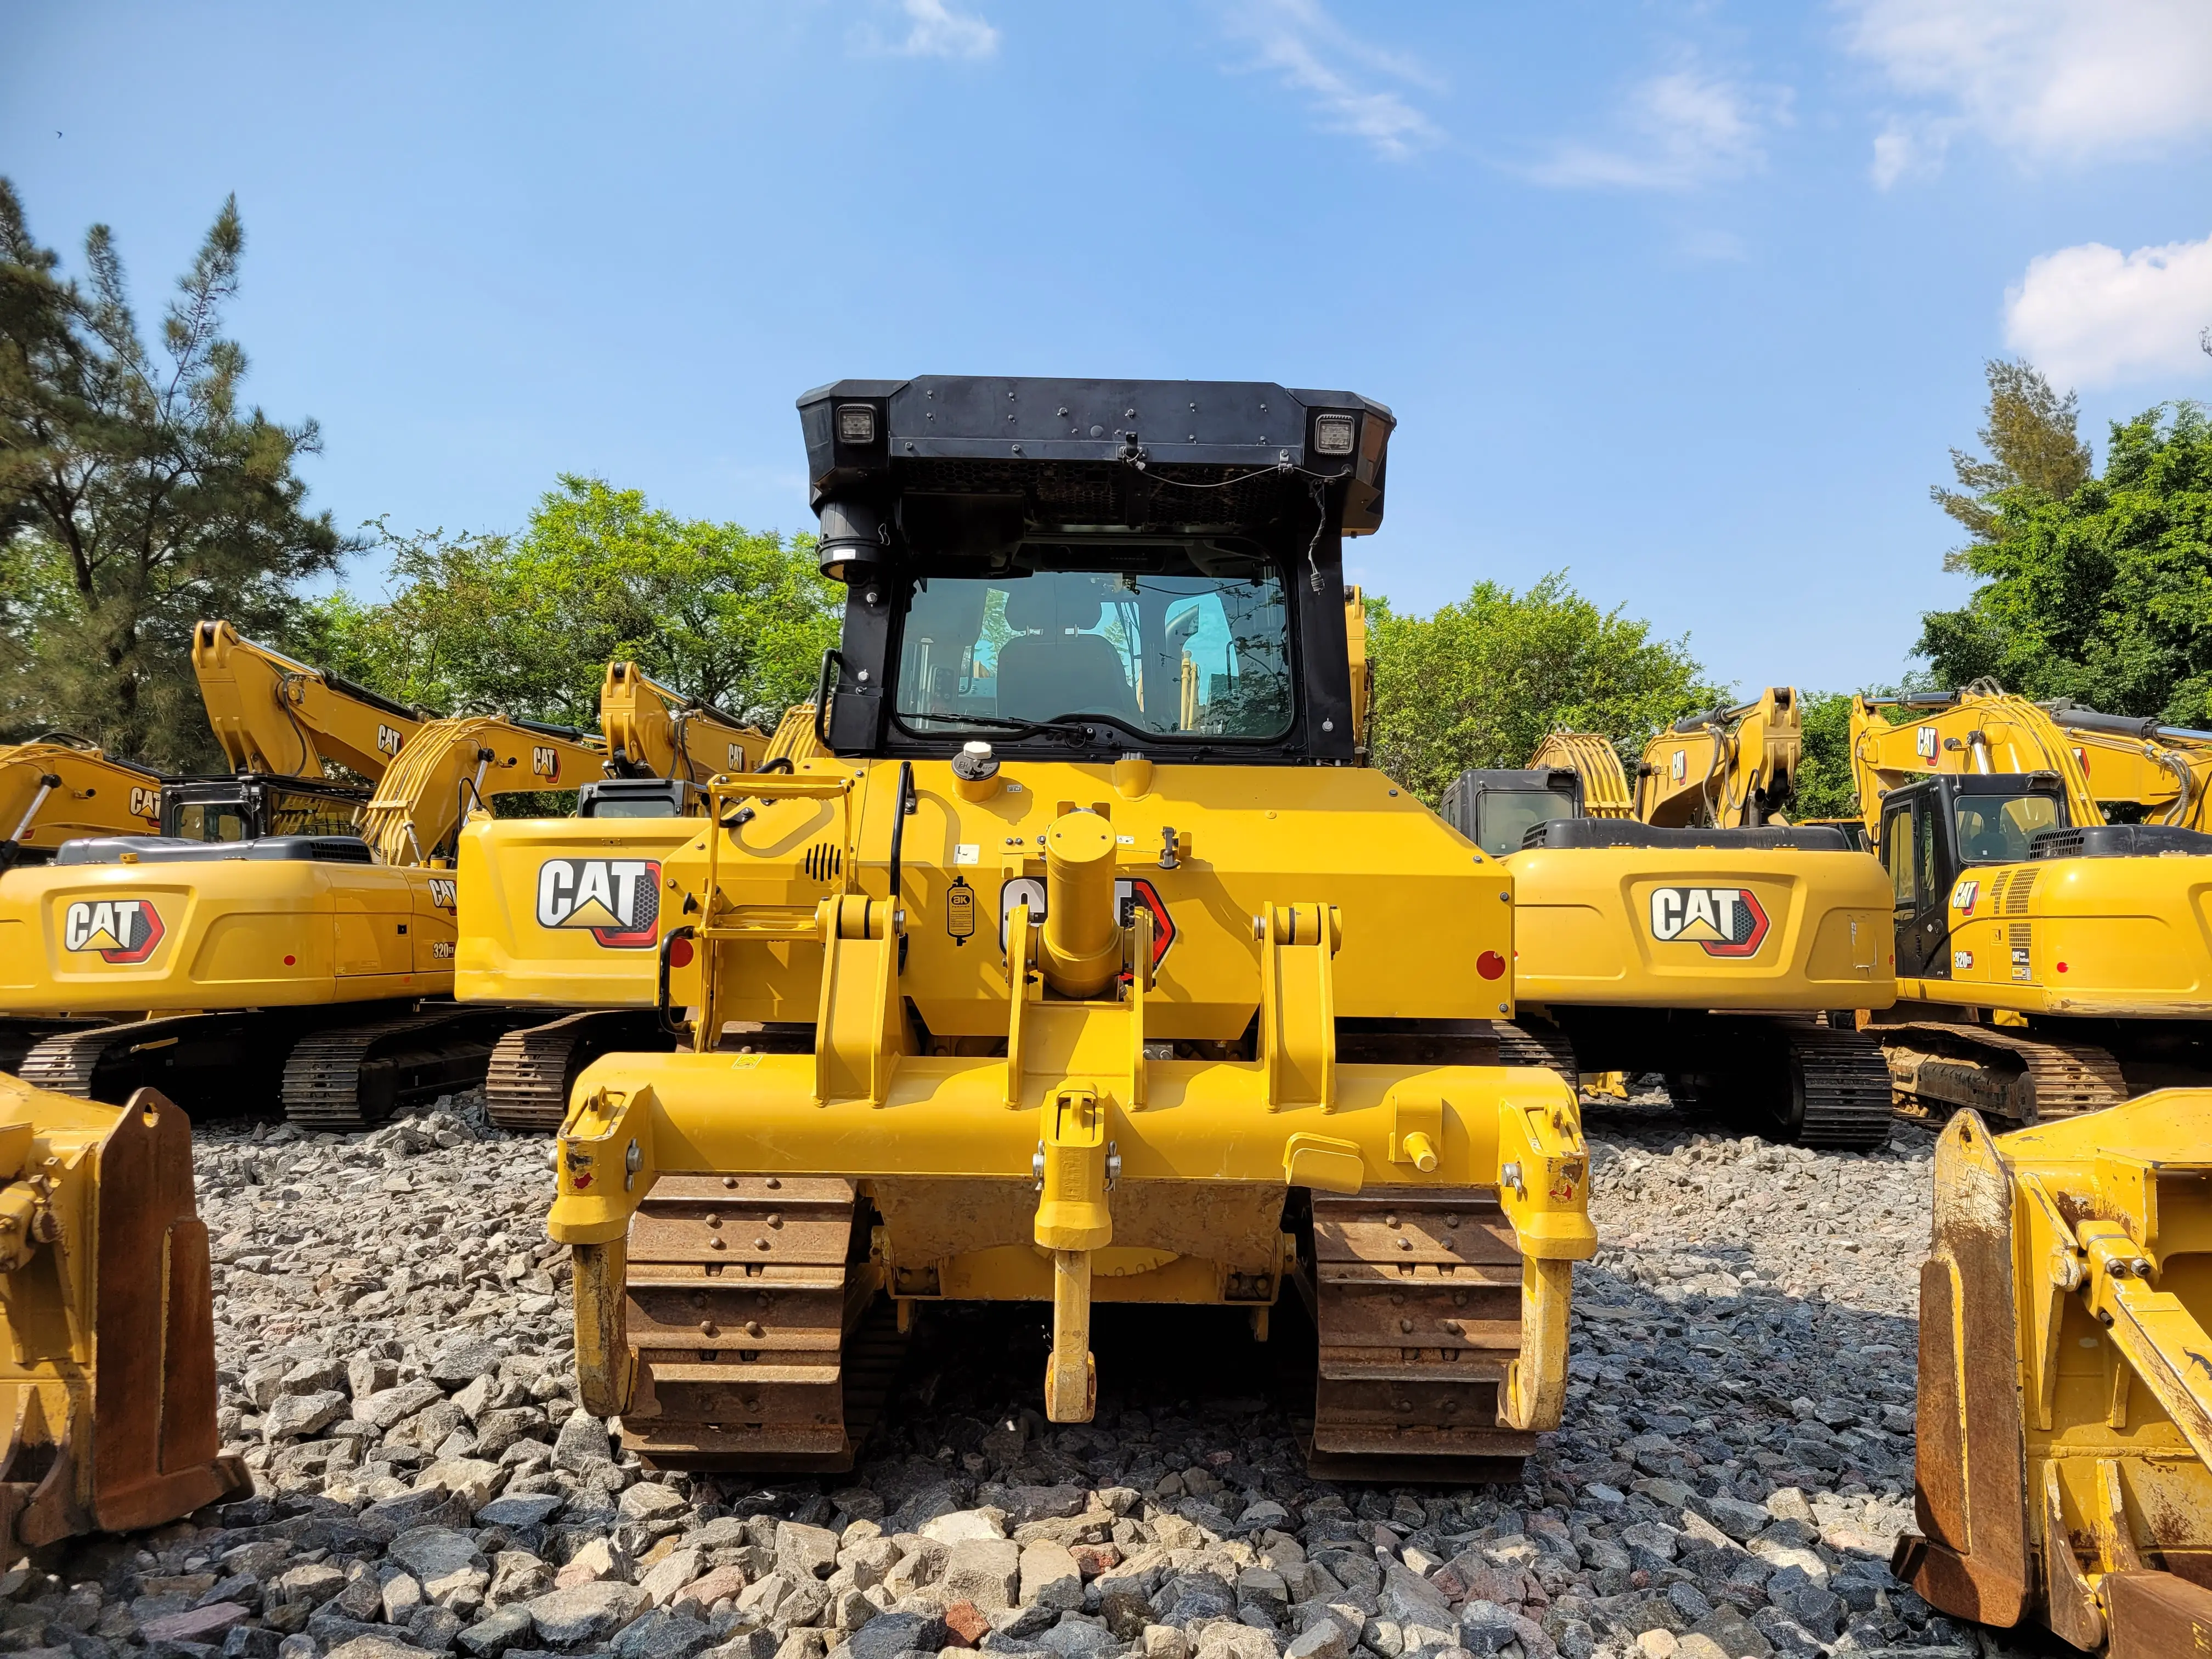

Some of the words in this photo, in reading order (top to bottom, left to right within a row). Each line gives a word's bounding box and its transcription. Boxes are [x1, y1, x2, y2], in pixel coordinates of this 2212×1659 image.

[378, 725, 400, 755] CAT
[1918, 727, 1936, 757] CAT
[534, 747, 554, 775] CAT
[729, 743, 743, 771] CAT
[1673, 751, 1684, 779] CAT
[131, 787, 161, 819] CAT
[428, 879, 456, 907] CAT
[536, 860, 645, 926] CAT
[1953, 882, 1977, 908] CAT
[66, 901, 139, 950] CAT
[1652, 889, 1740, 941] CAT
